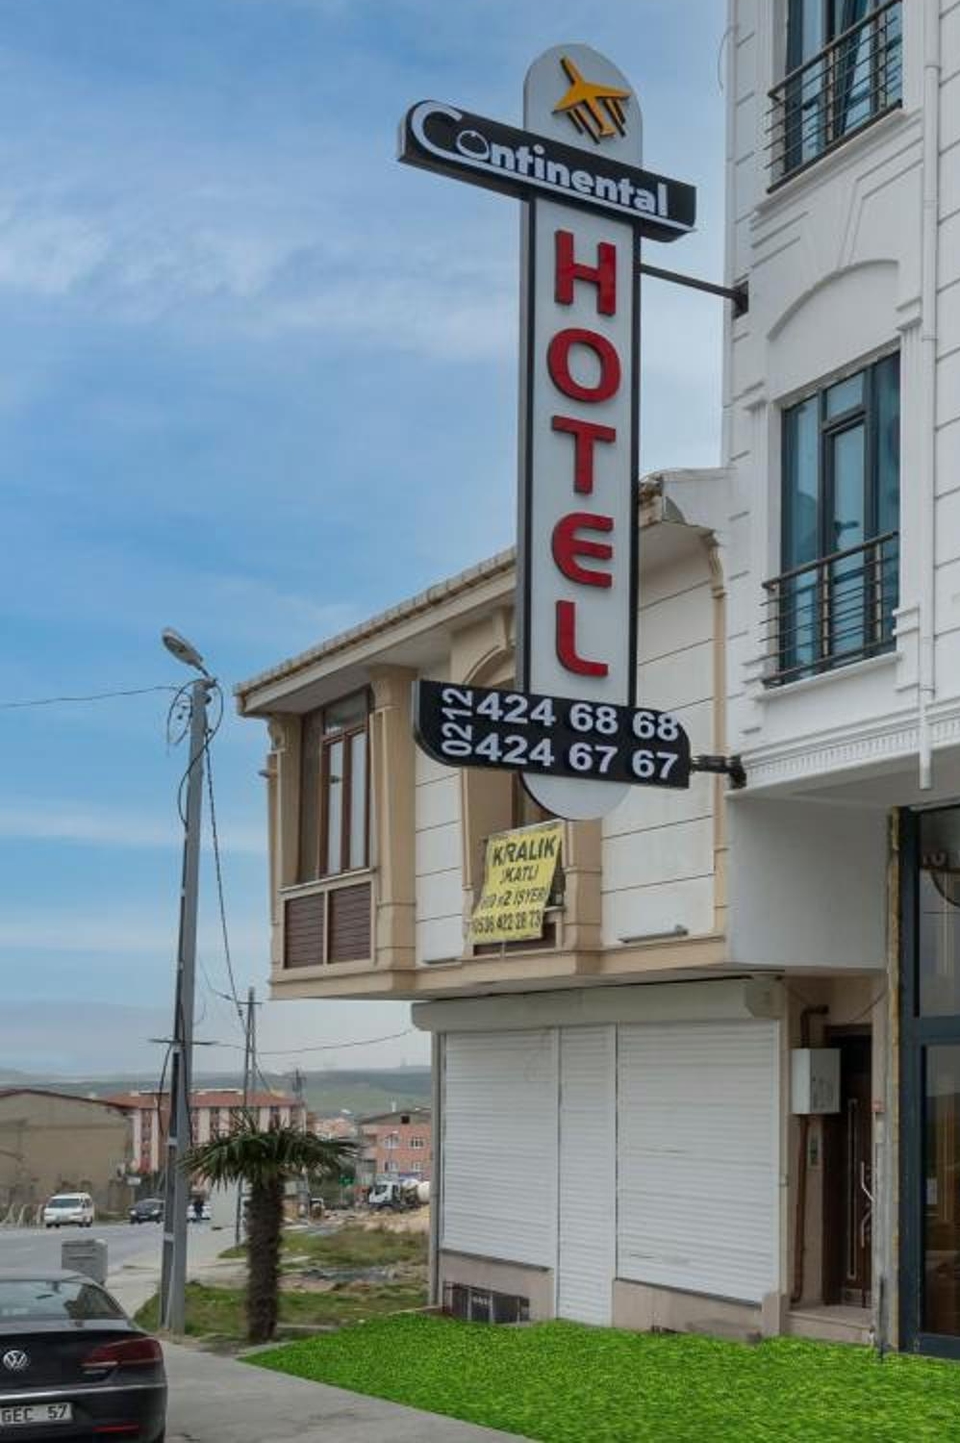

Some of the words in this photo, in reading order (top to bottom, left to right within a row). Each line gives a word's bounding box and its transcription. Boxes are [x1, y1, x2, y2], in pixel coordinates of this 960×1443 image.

[411, 99, 671, 218] Continental
[547, 229, 622, 677] HOTEL
[441, 688, 473, 756] 0212
[476, 691, 557, 727] 424
[569, 703, 618, 735] 68
[632, 711, 680, 742] 68
[475, 732, 556, 767] 424
[568, 742, 619, 774] 67
[631, 749, 679, 779] 67
